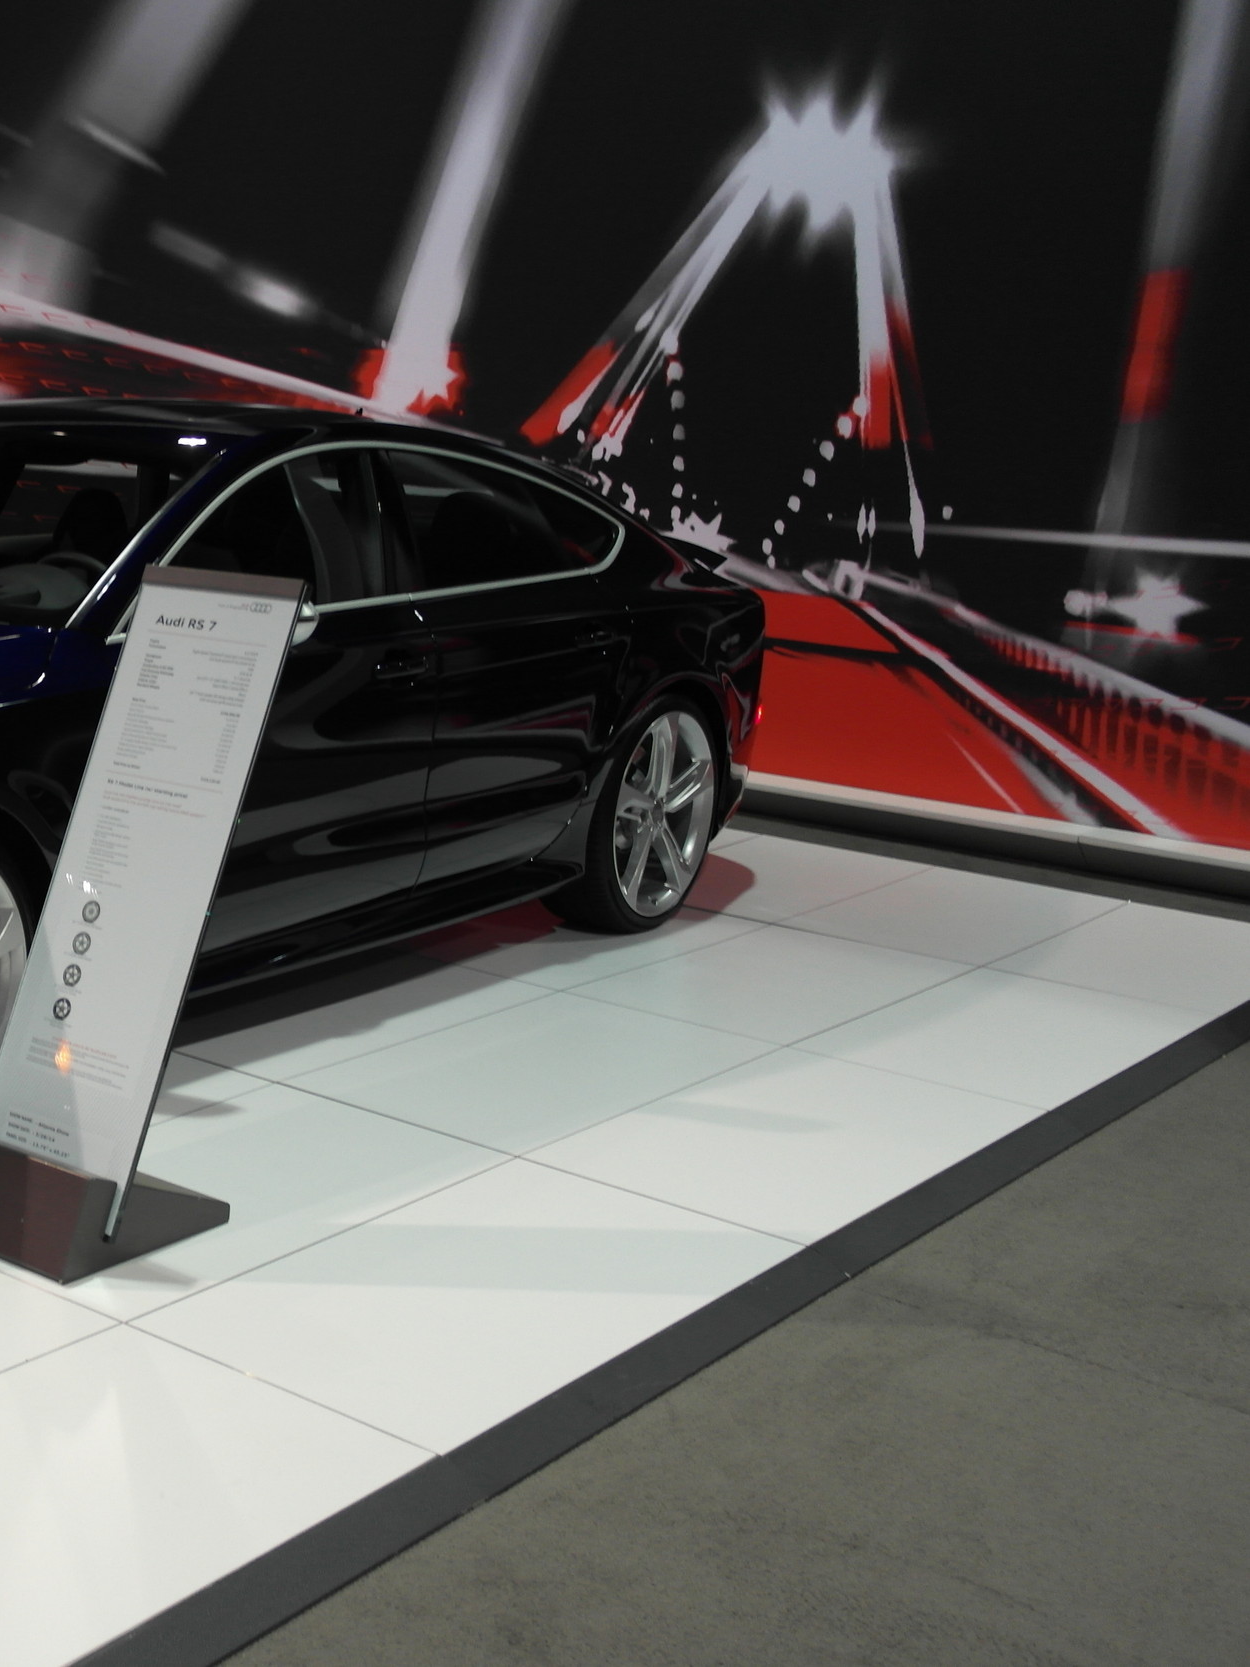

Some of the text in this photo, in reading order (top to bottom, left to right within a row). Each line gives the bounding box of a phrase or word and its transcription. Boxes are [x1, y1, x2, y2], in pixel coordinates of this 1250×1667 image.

[155, 613, 218, 632] Audi RS 7
